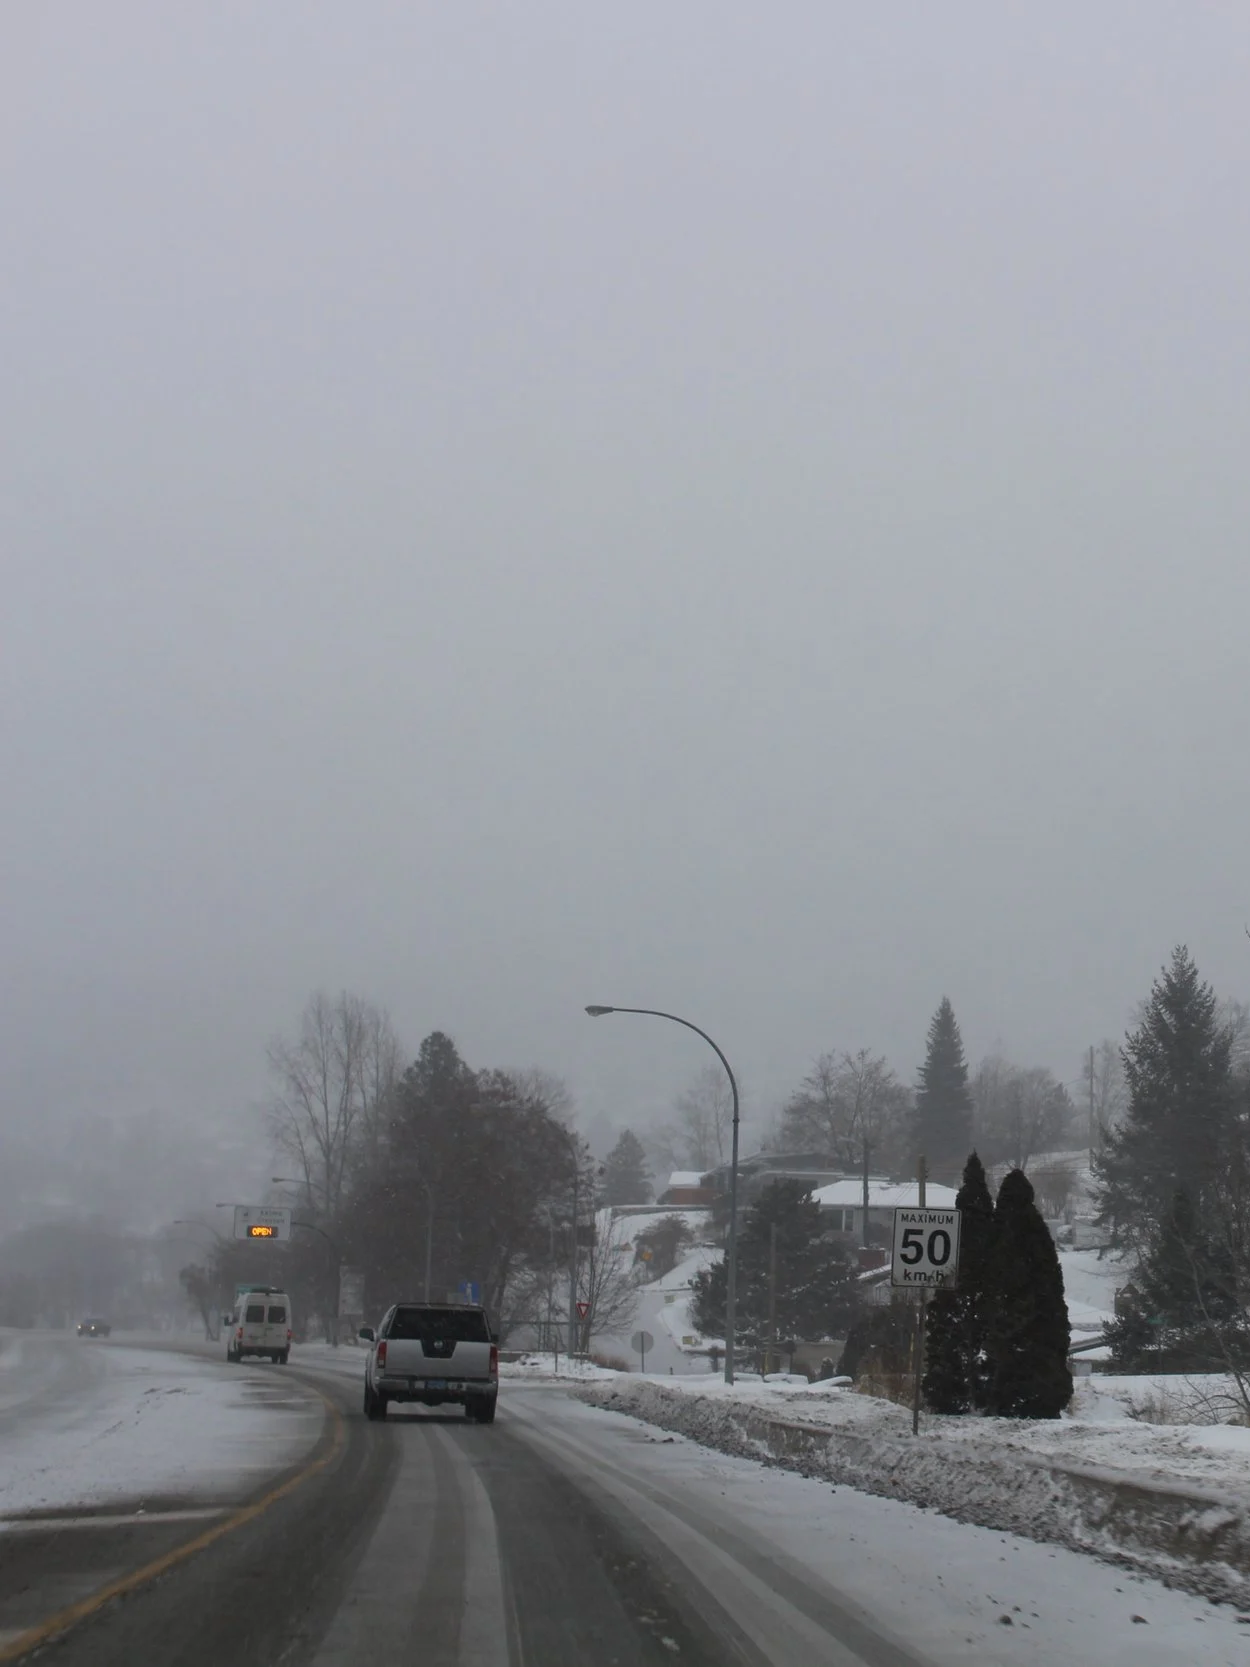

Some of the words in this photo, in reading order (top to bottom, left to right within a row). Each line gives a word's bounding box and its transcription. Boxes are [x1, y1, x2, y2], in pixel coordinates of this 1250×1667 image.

[900, 1213, 954, 1225] MAXIMUM
[251, 1227, 272, 1236] OPEN
[899, 1228, 951, 1266] 50
